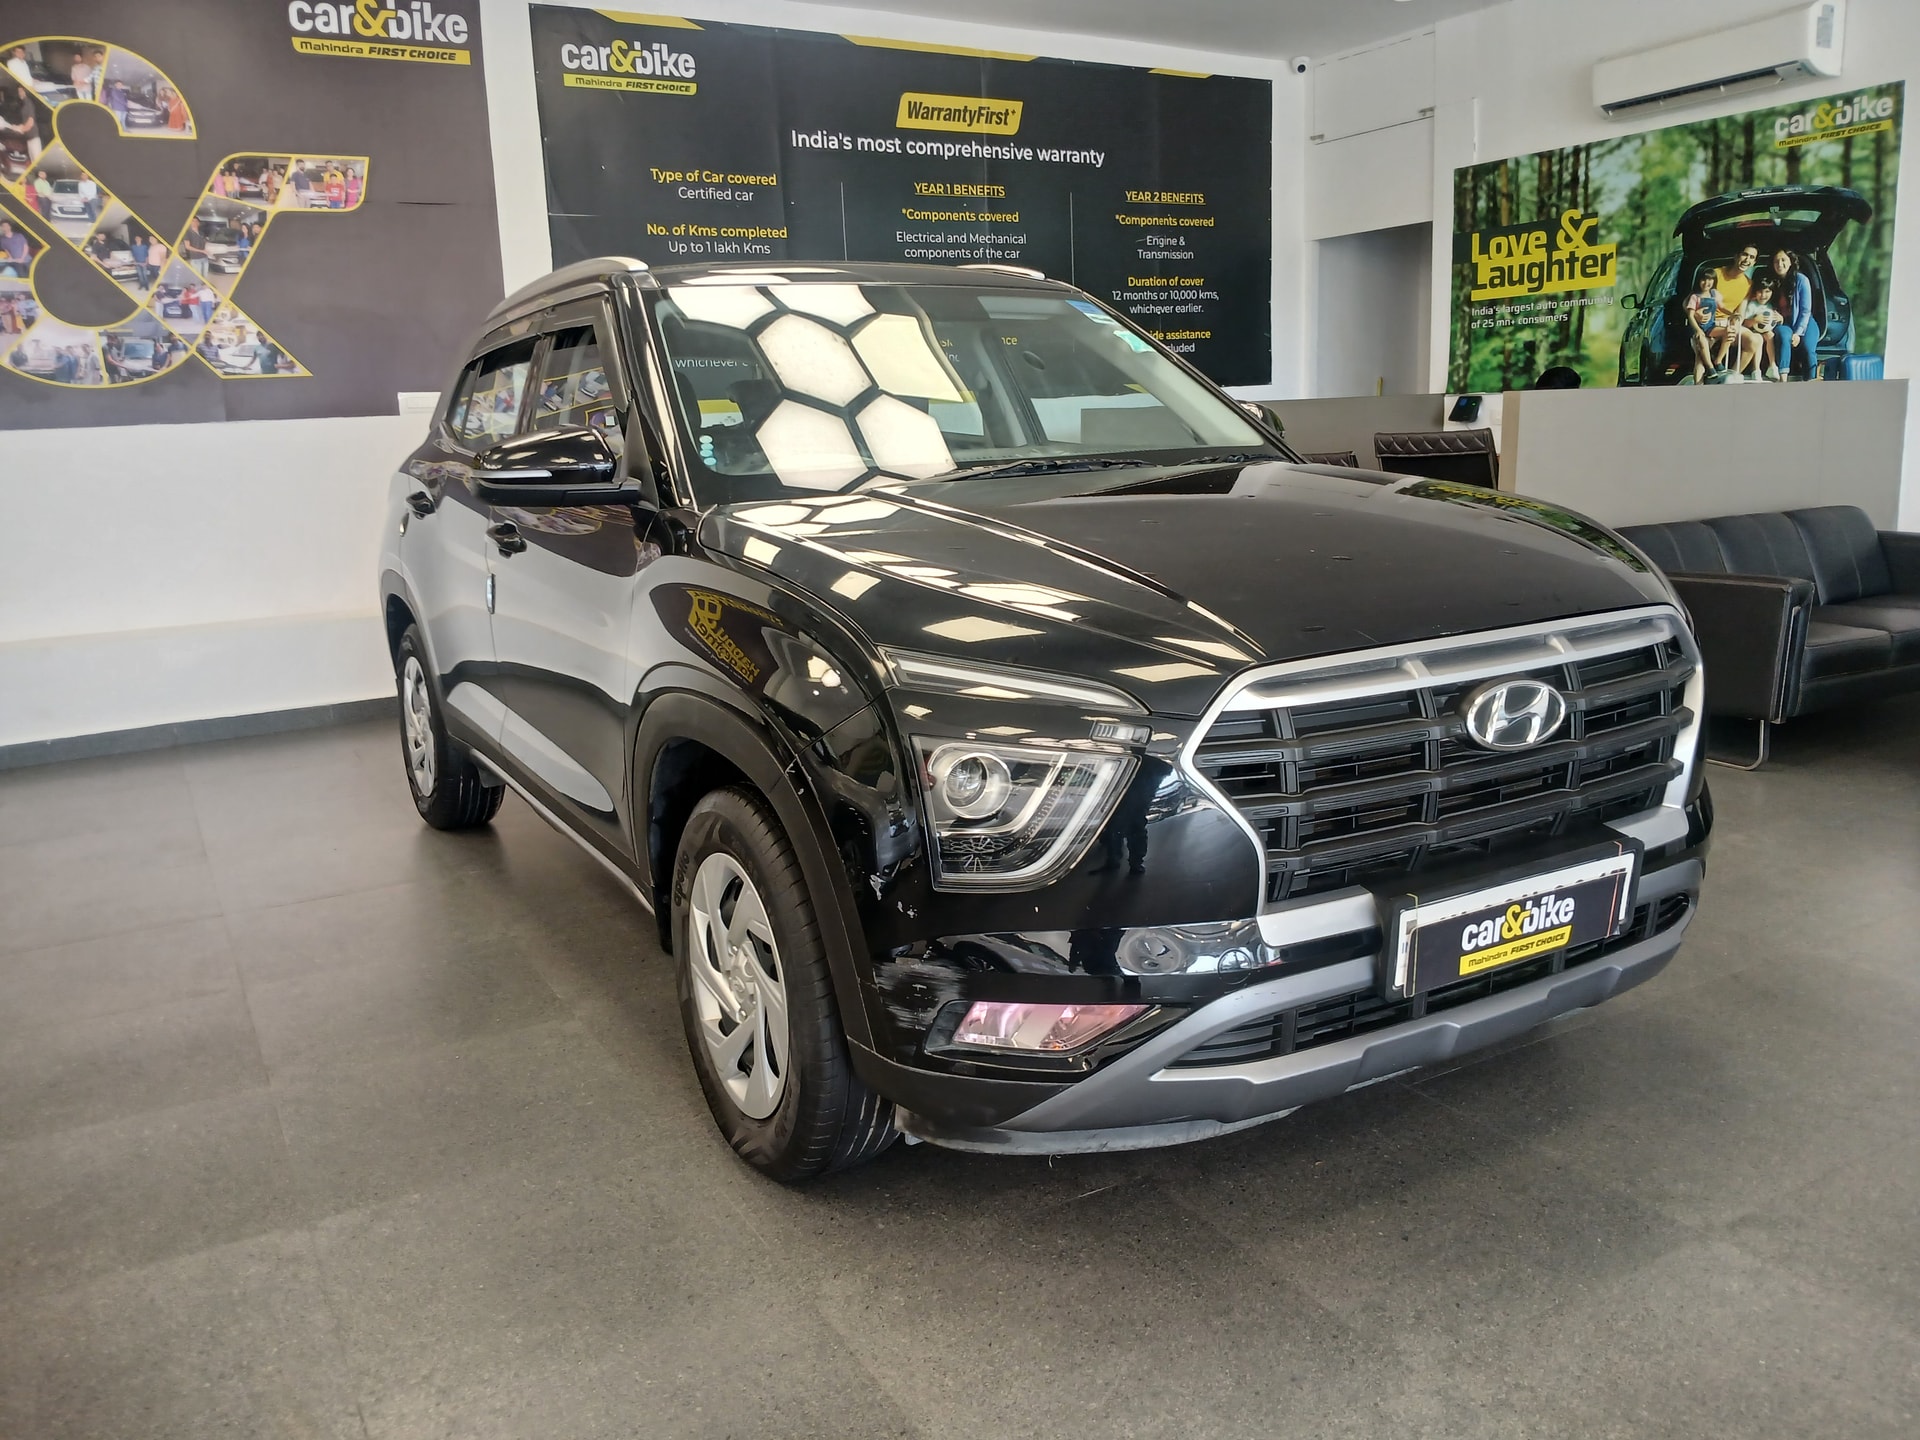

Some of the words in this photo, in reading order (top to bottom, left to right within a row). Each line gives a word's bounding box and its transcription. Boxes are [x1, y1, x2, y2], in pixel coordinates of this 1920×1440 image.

[288, 0, 468, 44] car&bike
[300, 41, 363, 54] Mahindra
[368, 46, 407, 58] FIRST
[409, 50, 457, 61] CHOICE
[561, 39, 696, 78] car&bike
[575, 77, 622, 88] Mahindra
[626, 81, 655, 90] FIRST
[656, 83, 691, 93] CHOICE
[1775, 95, 1893, 137] car&bike
[1778, 136, 1818, 147] Mahindra
[1820, 130, 1846, 140] FIRST
[1847, 123, 1882, 135] CHOICE
[791, 130, 853, 150] India's
[857, 137, 902, 154] most
[906, 138, 1033, 161] comprehensive
[1037, 148, 1105, 168] warranty
[650, 168, 683, 184] Type
[686, 170, 700, 183] of
[702, 171, 724, 184] Car
[727, 174, 777, 186] covered
[678, 186, 732, 200] Certified
[734, 191, 754, 201] car
[914, 182, 944, 195] YEAR
[946, 184, 951, 195] 1
[953, 184, 1005, 198] BENEFITS
[1125, 190, 1152, 202] YEAR
[1153, 191, 1160, 202] 2
[1161, 192, 1204, 204] BENEFITS
[978, 212, 1019, 223] covered
[1179, 217, 1215, 227] covered
[646, 223, 669, 236] No.
[672, 224, 686, 236] of
[689, 225, 717, 237] Kms
[720, 226, 788, 240] completed
[896, 231, 944, 243] Electrical
[946, 232, 967, 244] and
[969, 233, 1027, 245] Mechanical
[1471, 230, 1547, 263] Love
[1556, 209, 1598, 251] &
[668, 240, 688, 255] Up
[691, 242, 704, 254] to
[706, 241, 712, 253] 1
[714, 241, 740, 254] lakh
[744, 243, 771, 255] Kms
[1146, 235, 1178, 248] Engine
[1178, 236, 1186, 246] &
[904, 247, 971, 260] components
[973, 248, 984, 259] of
[986, 248, 1000, 259] the
[1001, 249, 1021, 259] car
[1136, 249, 1194, 260] Transmission
[1471, 250, 1614, 293] Laughter
[1128, 276, 1168, 287] Duration
[1169, 276, 1179, 287] of
[1180, 278, 1205, 287] cover
[1112, 290, 1122, 301] 12
[1123, 290, 1158, 301] months
[1159, 292, 1168, 300] or
[1169, 289, 1197, 301] 10,000
[1199, 289, 1220, 301] kms,
[1129, 303, 1174, 314] whichever
[1175, 303, 1204, 313] earlier.
[1471, 305, 1500, 317] India's
[1502, 302, 1534, 316] largest
[1536, 300, 1557, 311] auto
[1559, 296, 1614, 308] community
[1471, 319, 1481, 329] of
[1482, 317, 1494, 328] 25
[1496, 317, 1515, 328] mn+
[1518, 312, 1568, 325] consumers
[1166, 329, 1211, 340] assistance
[1461, 894, 1575, 951] car&bike
[1468, 950, 1509, 967] Mahindra
[1510, 941, 1535, 954] FIRST
[1535, 932, 1566, 947] CHOICE
